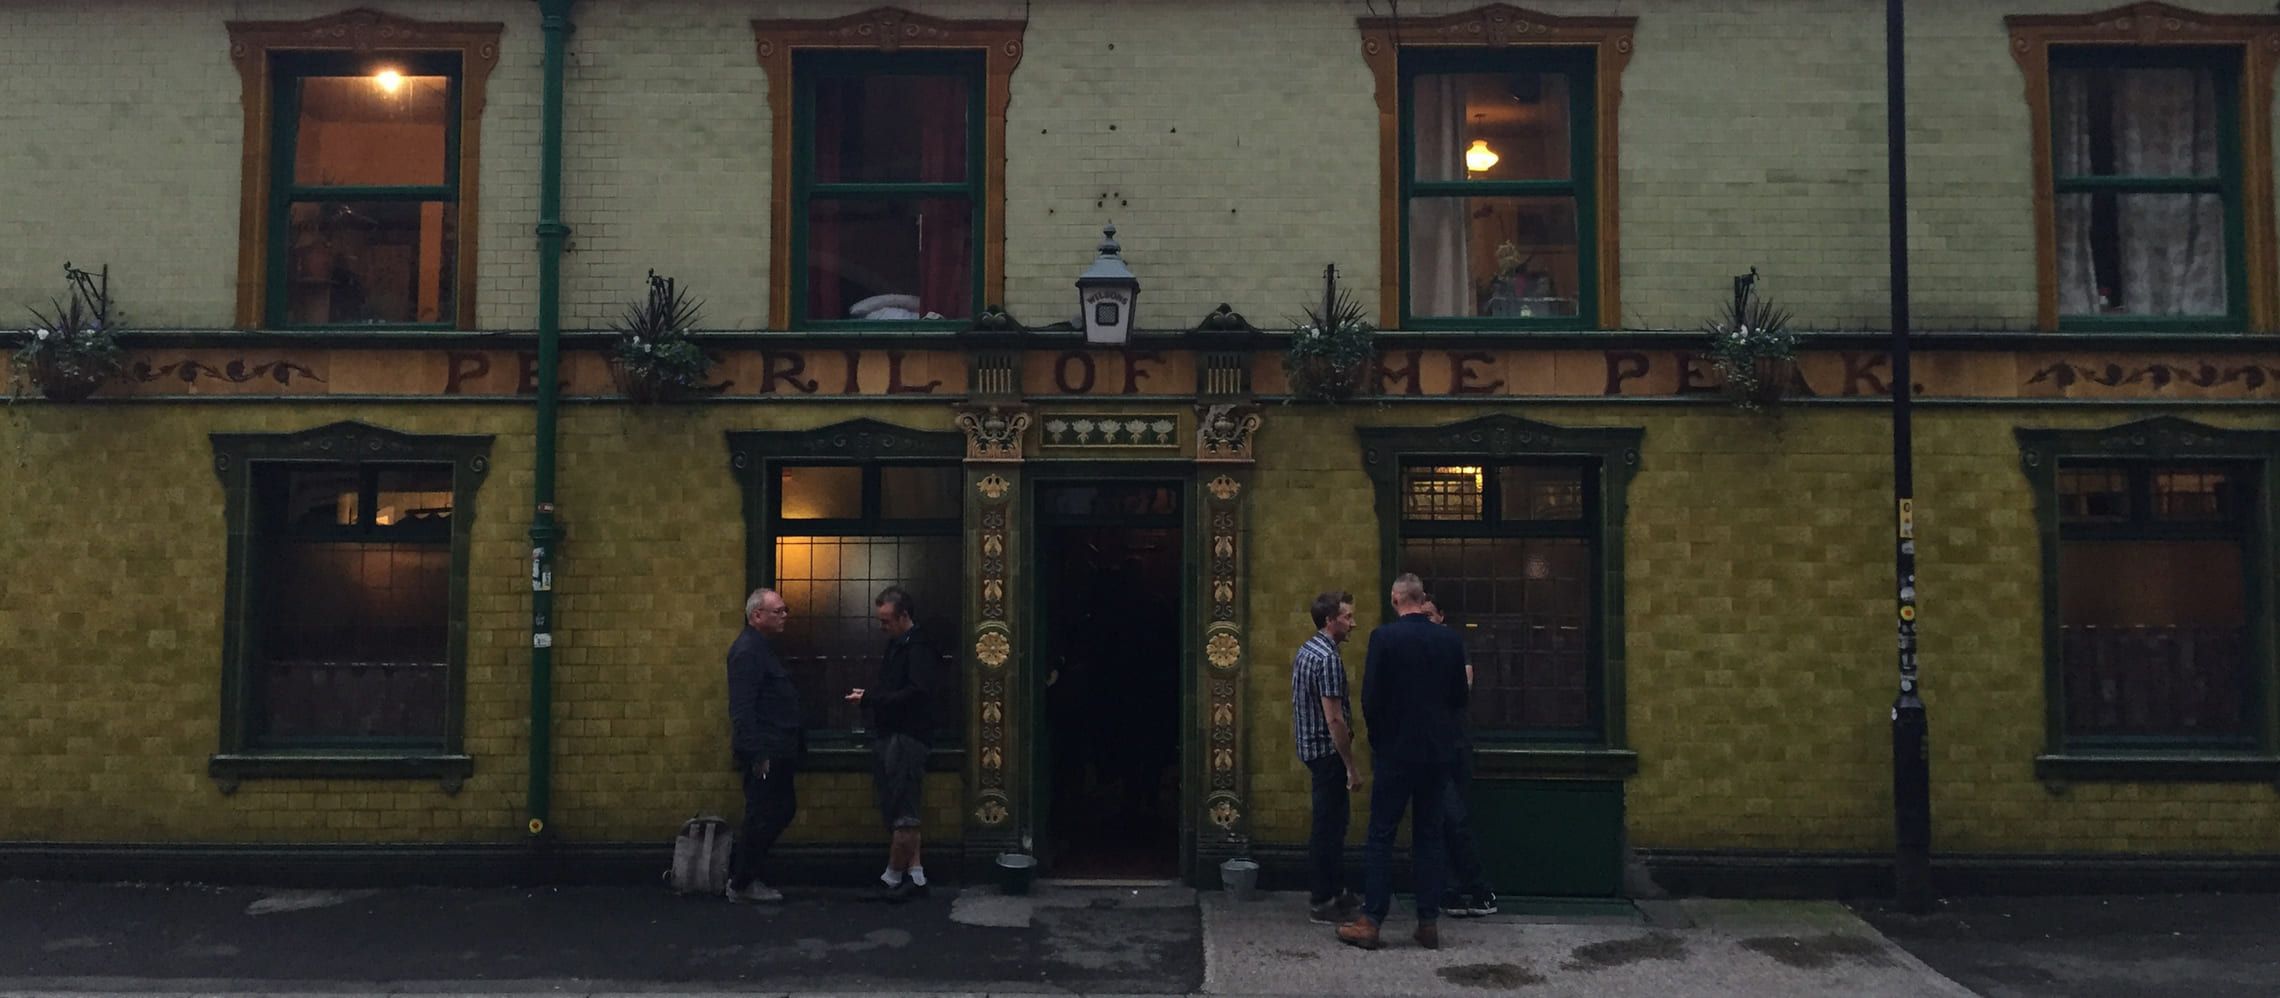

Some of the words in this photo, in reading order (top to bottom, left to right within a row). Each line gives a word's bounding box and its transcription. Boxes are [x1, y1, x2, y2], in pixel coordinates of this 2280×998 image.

[444, 350, 941, 394] PERIL
[1055, 350, 1166, 394] OF
[1287, 350, 1504, 394] HE
[1604, 350, 1925, 396] PEK.
